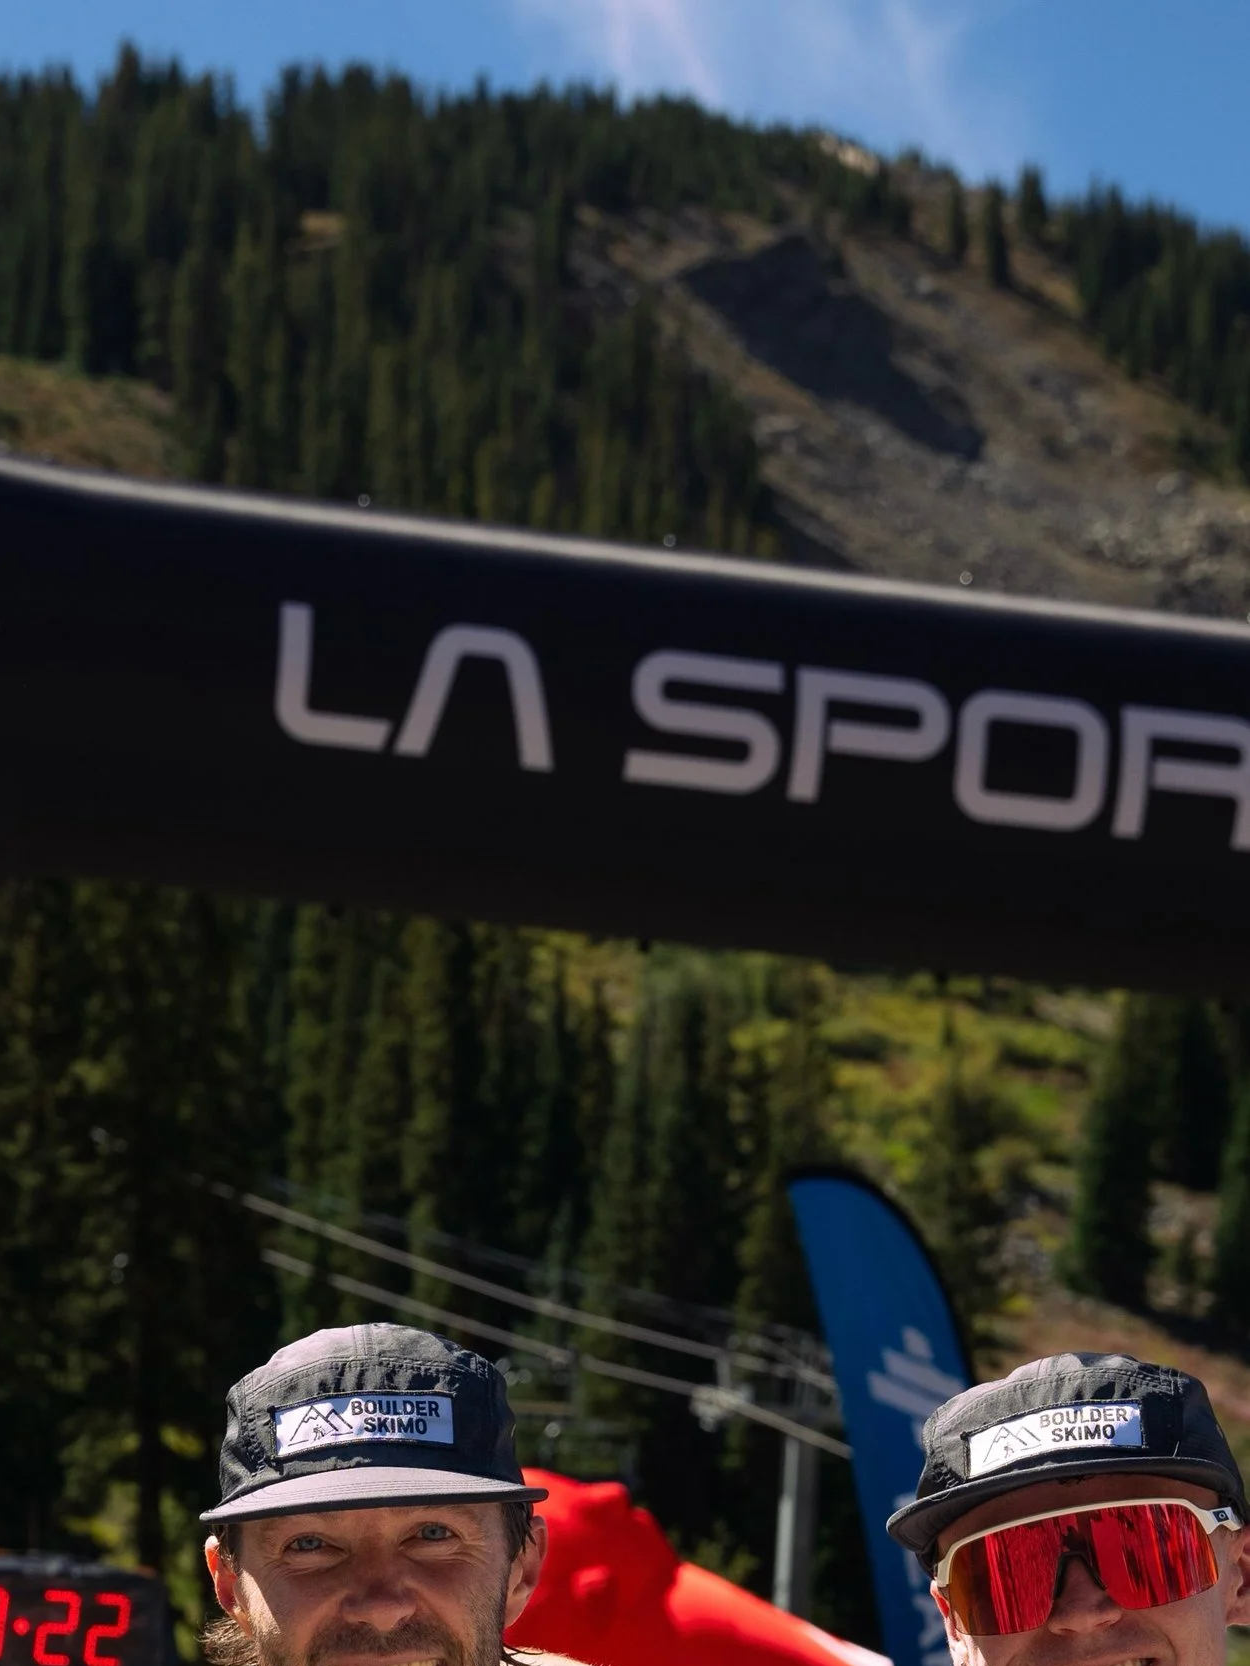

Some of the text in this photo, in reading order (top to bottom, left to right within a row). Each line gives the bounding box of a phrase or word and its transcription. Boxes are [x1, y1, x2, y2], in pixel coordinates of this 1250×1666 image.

[275, 602, 553, 773] LA
[351, 1400, 440, 1418] BOULDER
[1040, 1407, 1128, 1428] BOULDER
[363, 1417, 428, 1435] SKIMO
[1051, 1424, 1116, 1443] SKIMO
